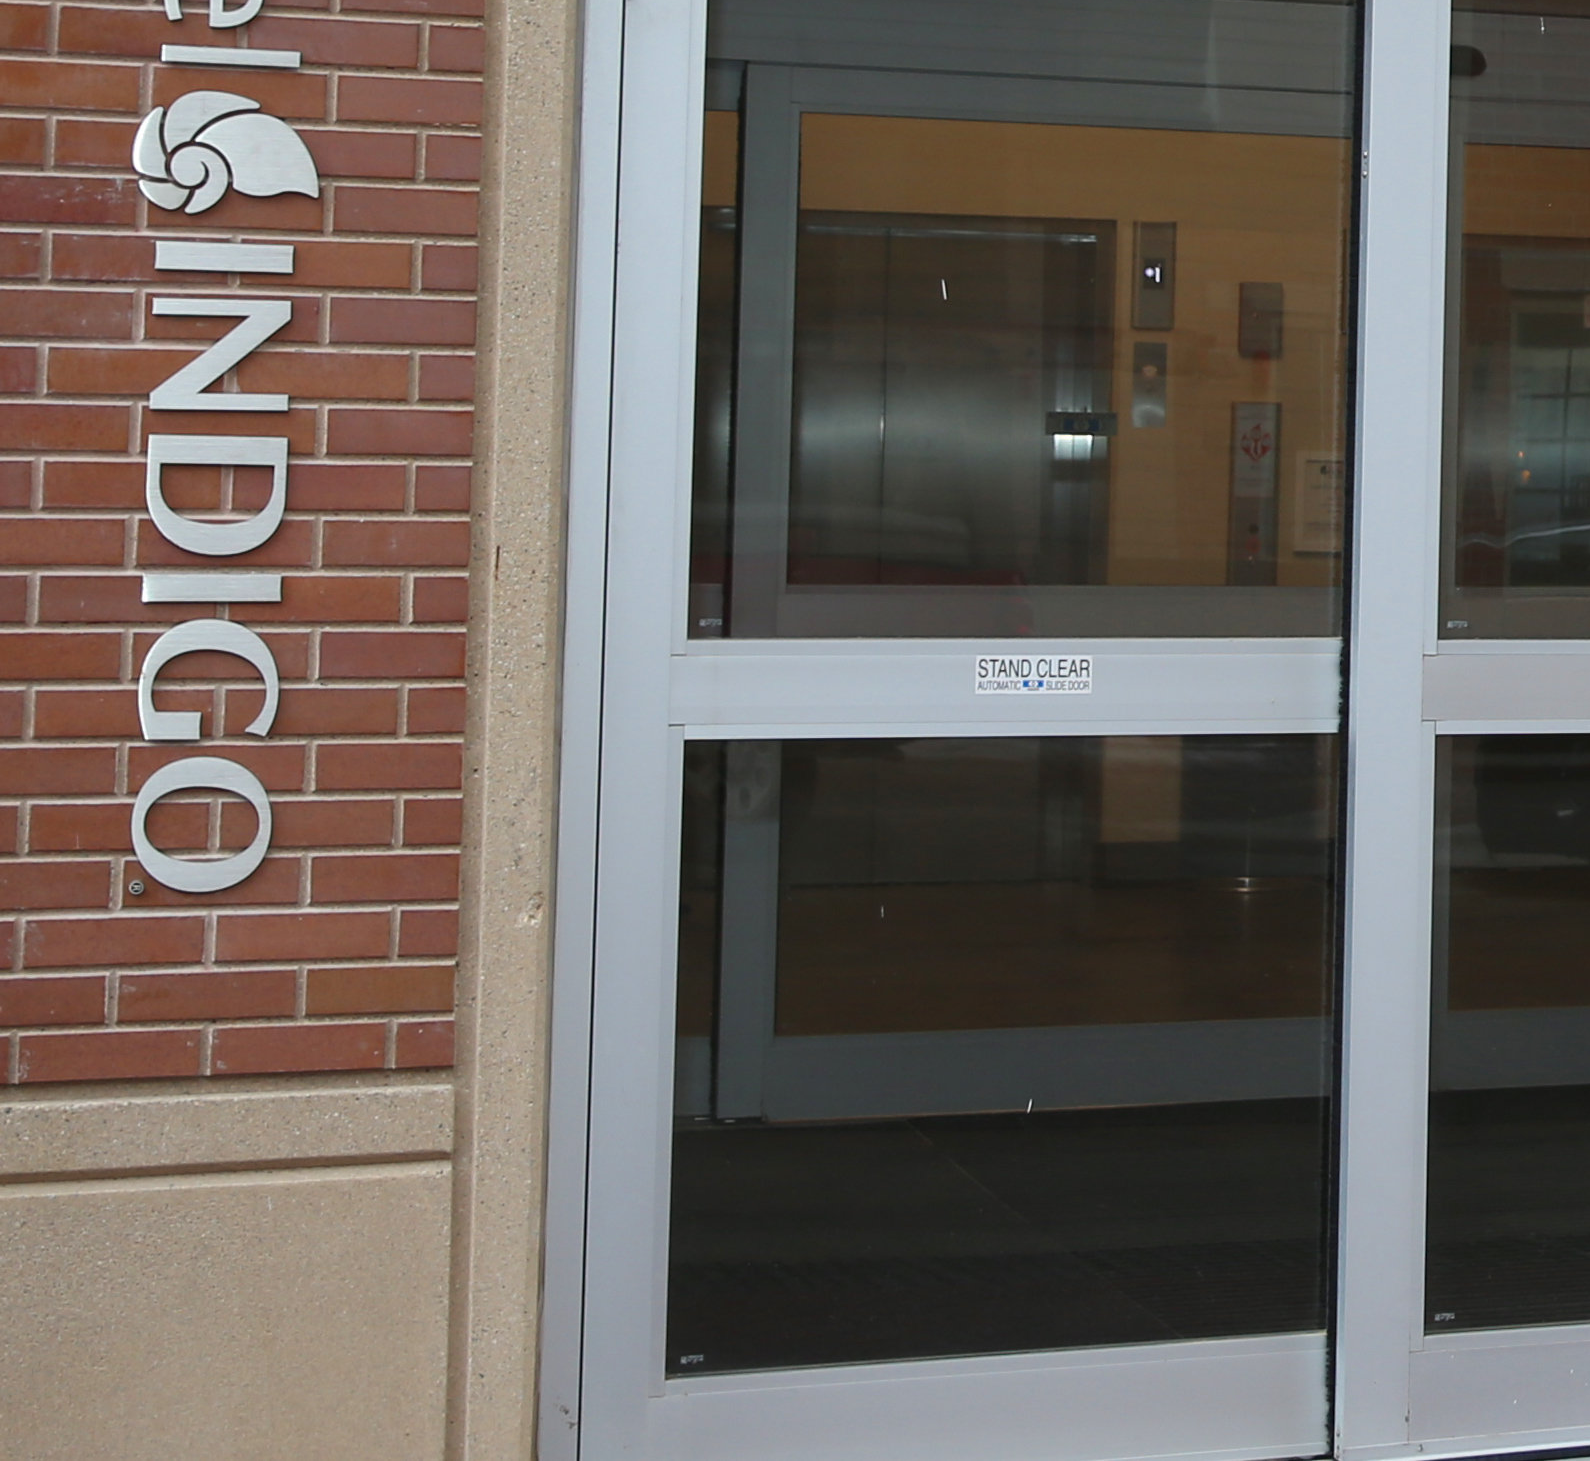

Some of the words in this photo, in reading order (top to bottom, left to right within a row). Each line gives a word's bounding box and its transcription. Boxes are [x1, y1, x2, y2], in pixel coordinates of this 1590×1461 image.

[130, 240, 295, 894] INDIGO
[977, 658, 1032, 678] STAND
[1036, 658, 1091, 678] CLEAR
[977, 680, 1022, 691] AUTOMATIC
[1045, 680, 1067, 691] SLIDE
[1068, 680, 1090, 691] DOOR
